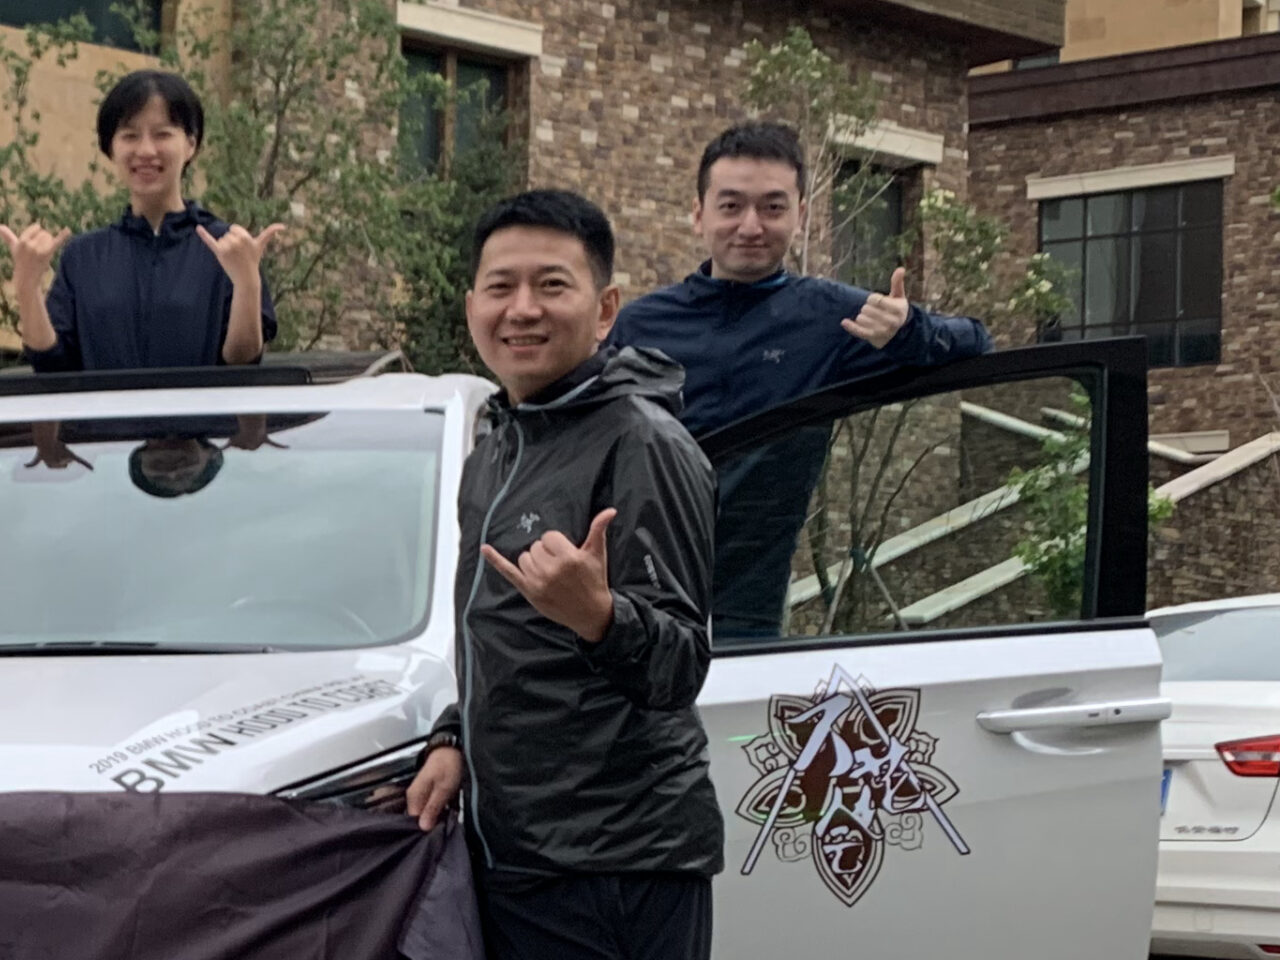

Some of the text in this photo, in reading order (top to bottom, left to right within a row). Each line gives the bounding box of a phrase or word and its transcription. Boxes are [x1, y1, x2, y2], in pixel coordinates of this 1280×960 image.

[89, 751, 129, 774] 2019
[125, 735, 169, 755] BMW
[111, 732, 238, 793] BMW
[219, 708, 309, 737] HOOD
[286, 697, 342, 711] TO
